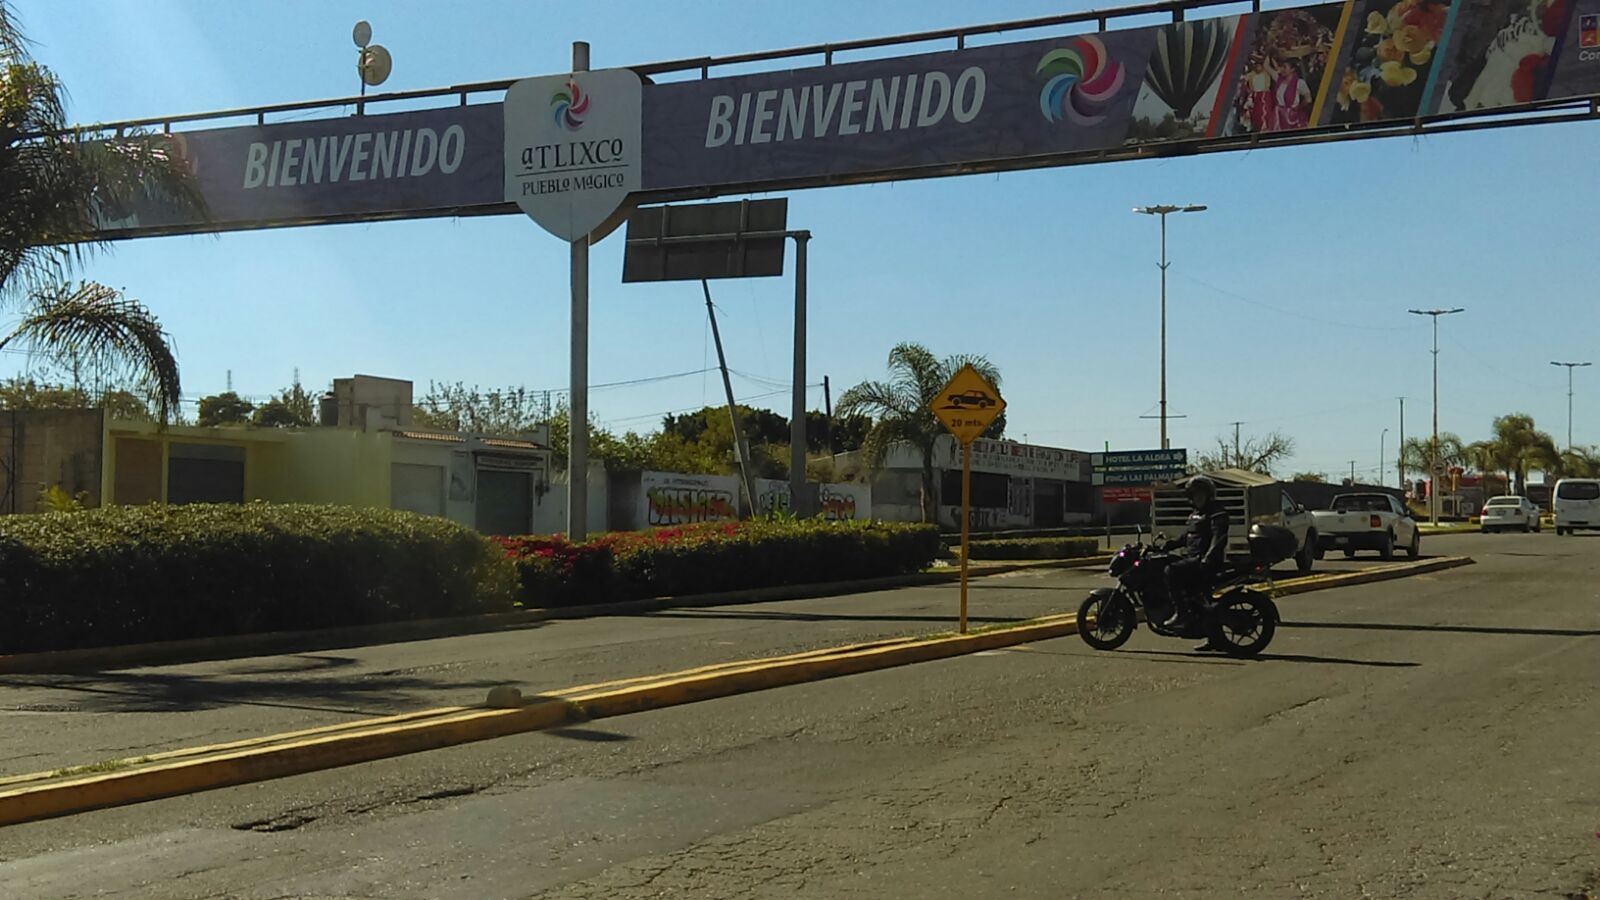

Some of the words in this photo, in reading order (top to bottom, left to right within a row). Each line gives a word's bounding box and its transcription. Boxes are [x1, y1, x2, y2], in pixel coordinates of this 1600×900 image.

[704, 66, 987, 149] BIENVENIDO
[243, 124, 466, 190] BIENVENIDO
[951, 419, 963, 427] 20
[1105, 455, 1131, 463] HOTEL
[1144, 453, 1171, 462] ALDEA
